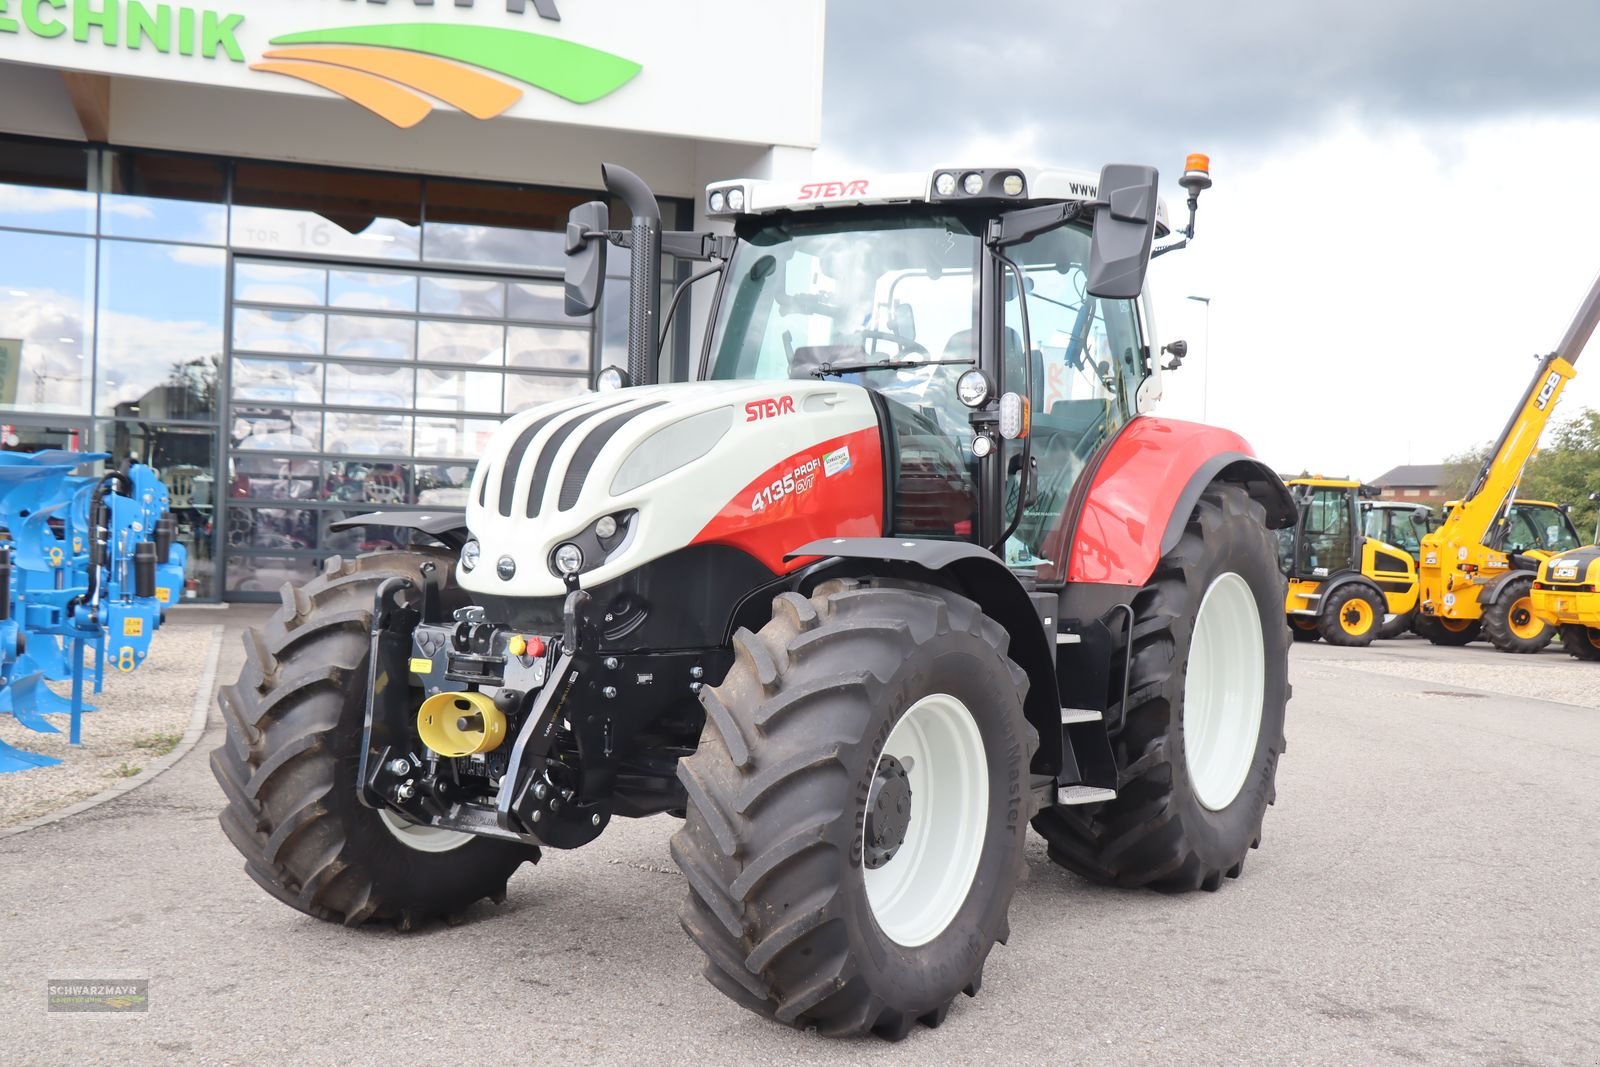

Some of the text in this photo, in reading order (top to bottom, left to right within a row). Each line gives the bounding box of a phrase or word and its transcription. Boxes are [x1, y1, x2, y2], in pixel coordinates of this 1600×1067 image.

[797, 180, 869, 200] STEYR
[246, 220, 331, 247] TOR 16
[1536, 371, 1561, 410] JCB
[745, 395, 796, 422] STEYR
[794, 458, 821, 479] PROFI
[751, 473, 795, 512] 4135
[796, 474, 815, 495] CVT
[1554, 567, 1575, 577] JCB
